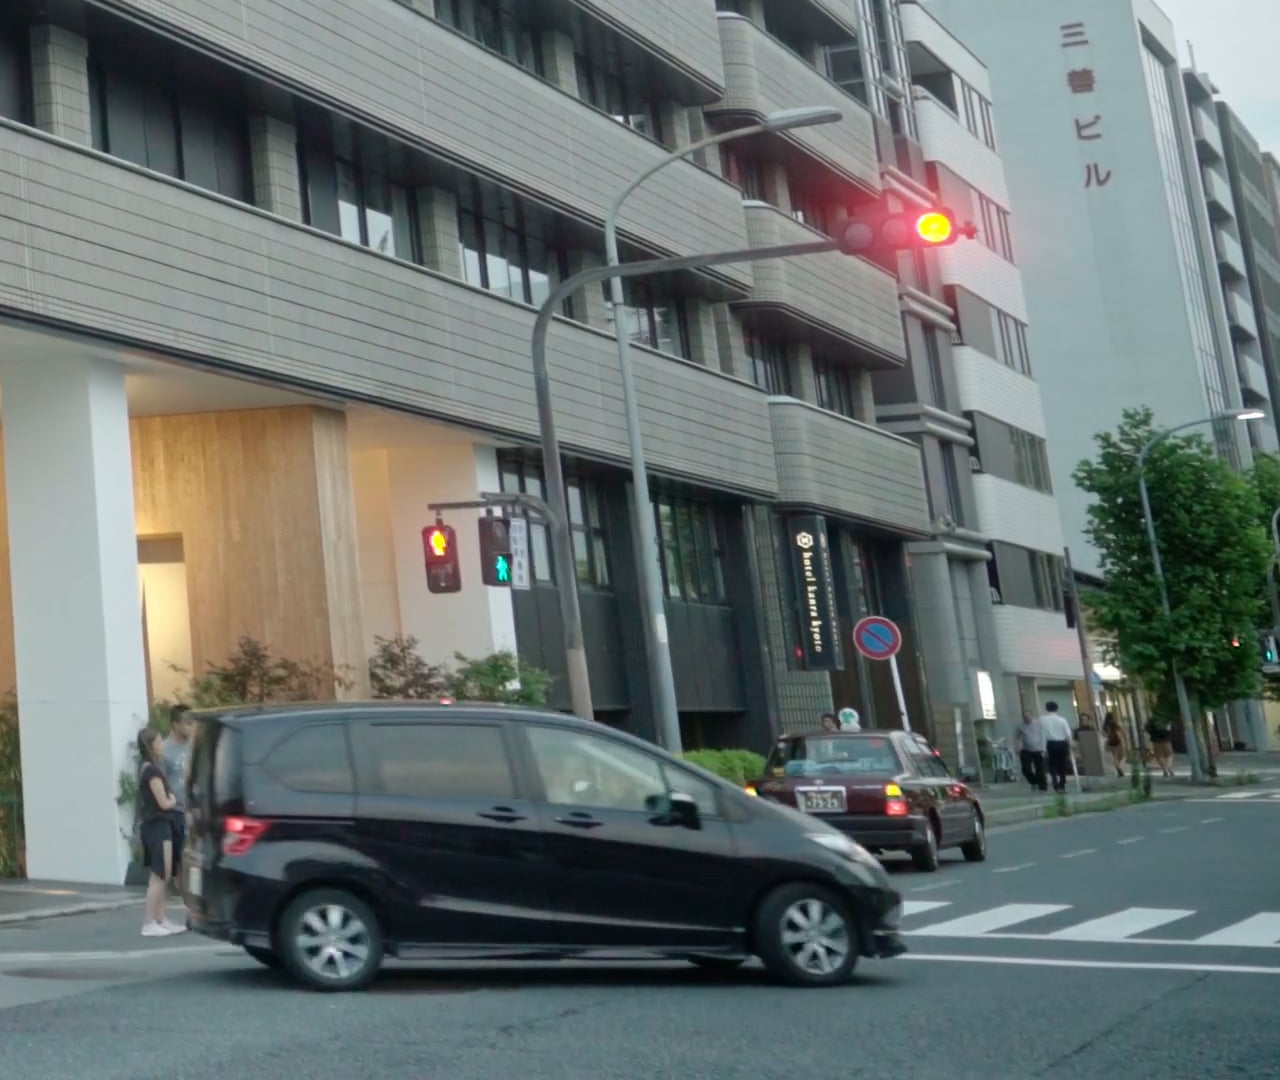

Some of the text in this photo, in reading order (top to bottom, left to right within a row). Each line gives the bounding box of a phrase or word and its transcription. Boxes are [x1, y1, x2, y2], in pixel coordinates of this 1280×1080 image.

[802, 552, 822, 653] hotel kanra kyoto
